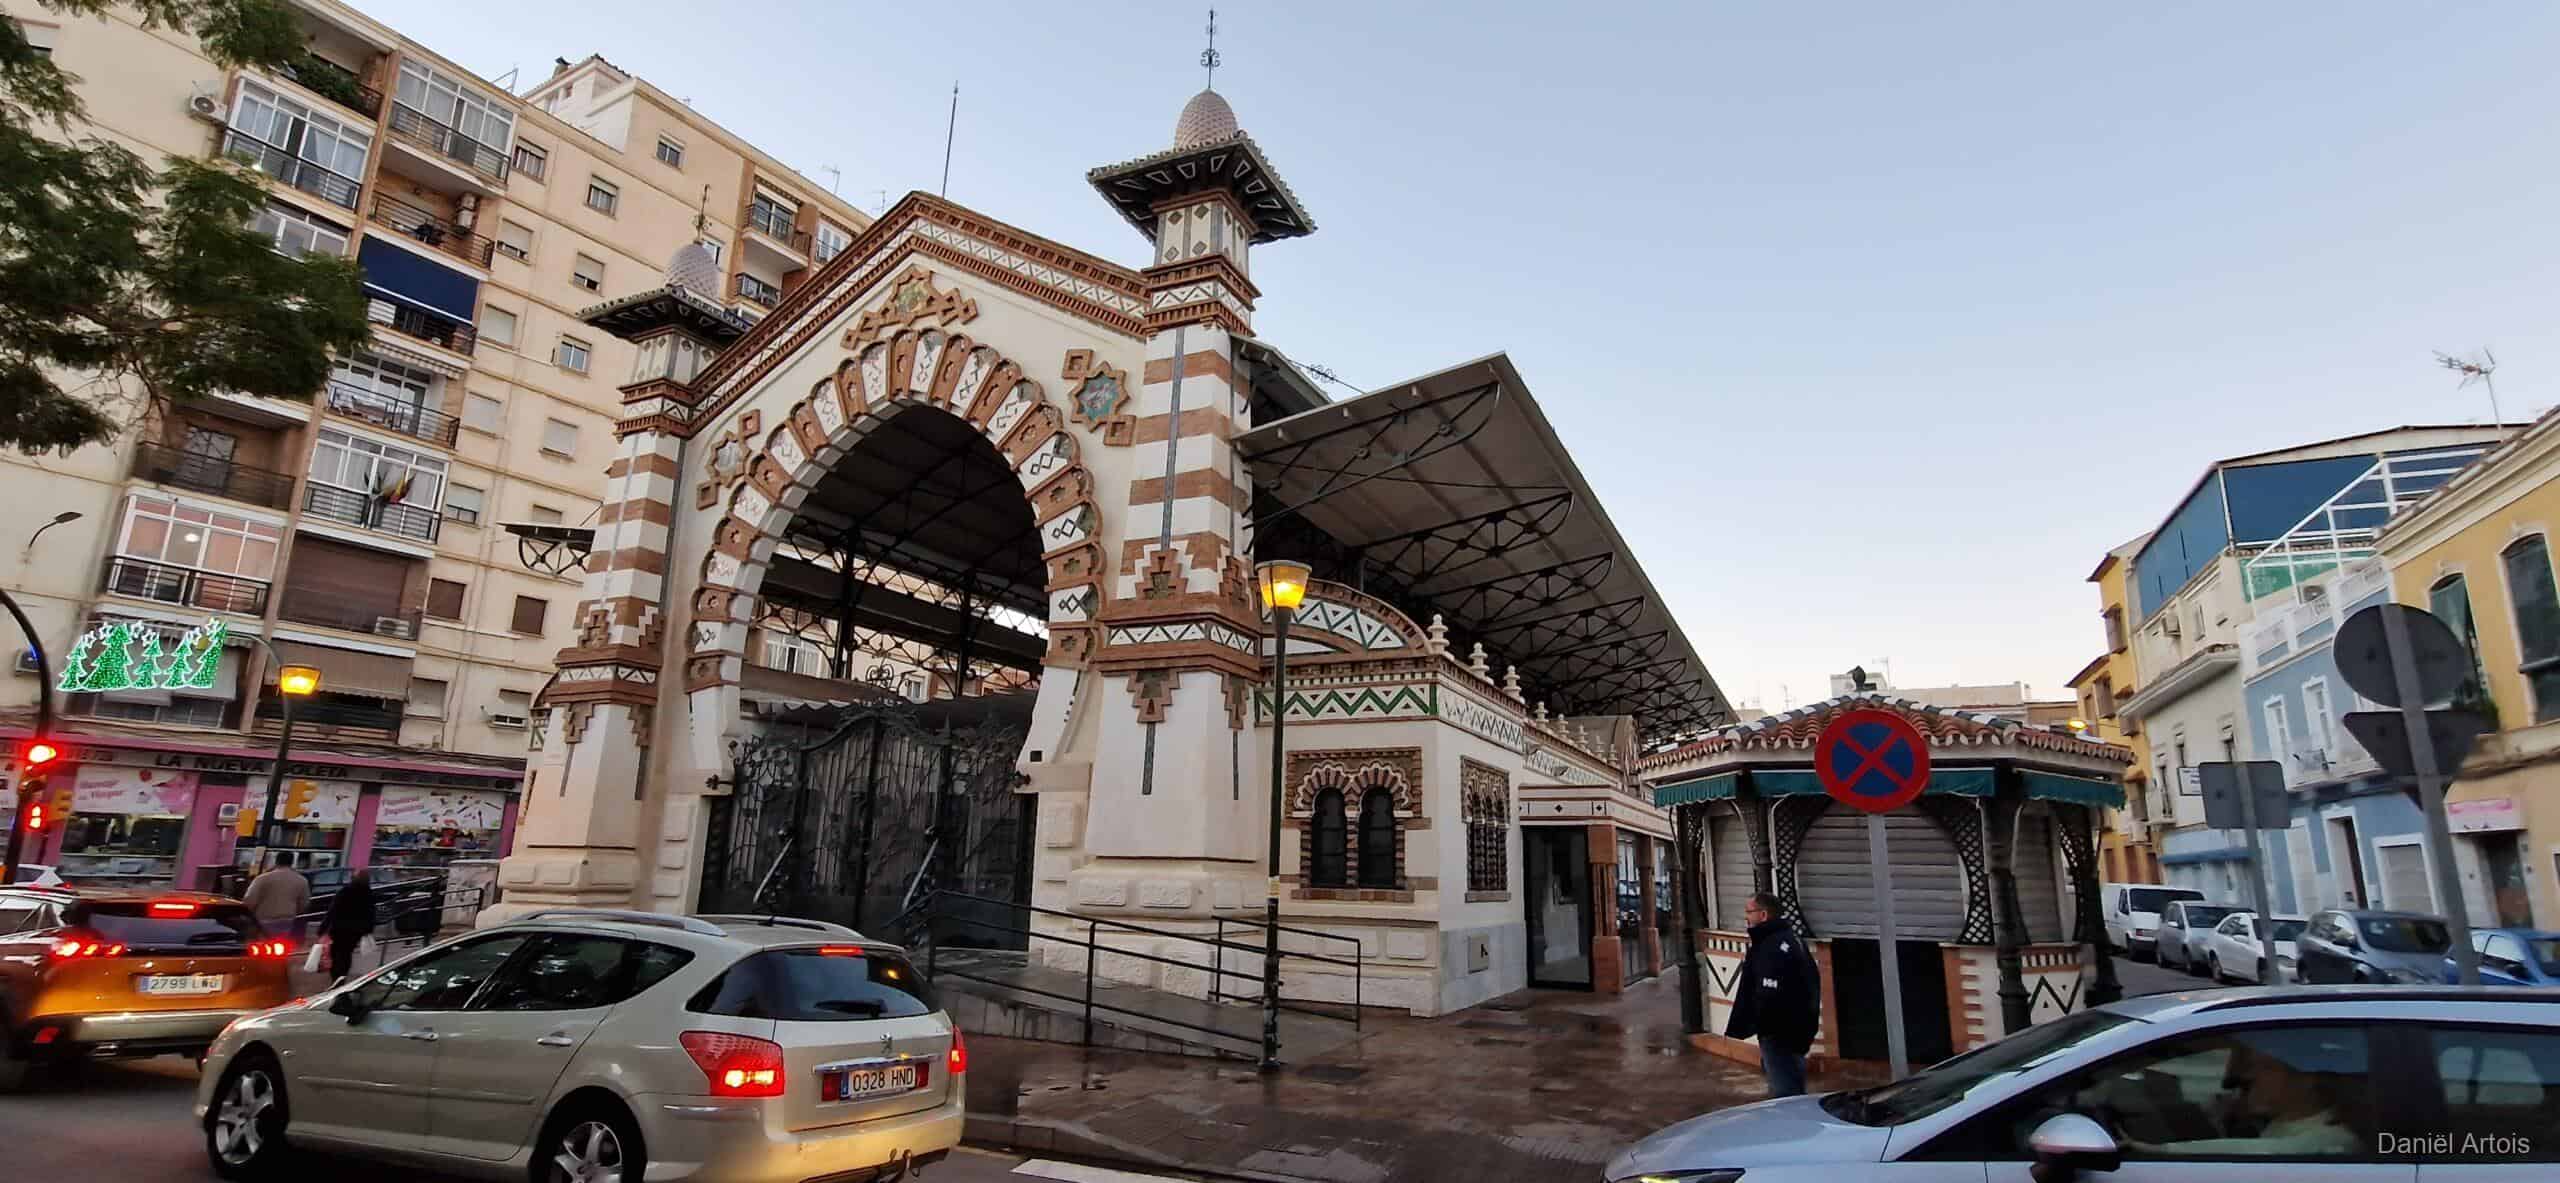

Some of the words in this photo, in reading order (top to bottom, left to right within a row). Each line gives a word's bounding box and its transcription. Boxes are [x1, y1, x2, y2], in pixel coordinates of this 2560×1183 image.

[155, 754, 182, 767] LA
[195, 757, 265, 773] NUEVA
[150, 978, 187, 990] 2799
[853, 1071, 886, 1092] 0328
[891, 1067, 914, 1088] HND
